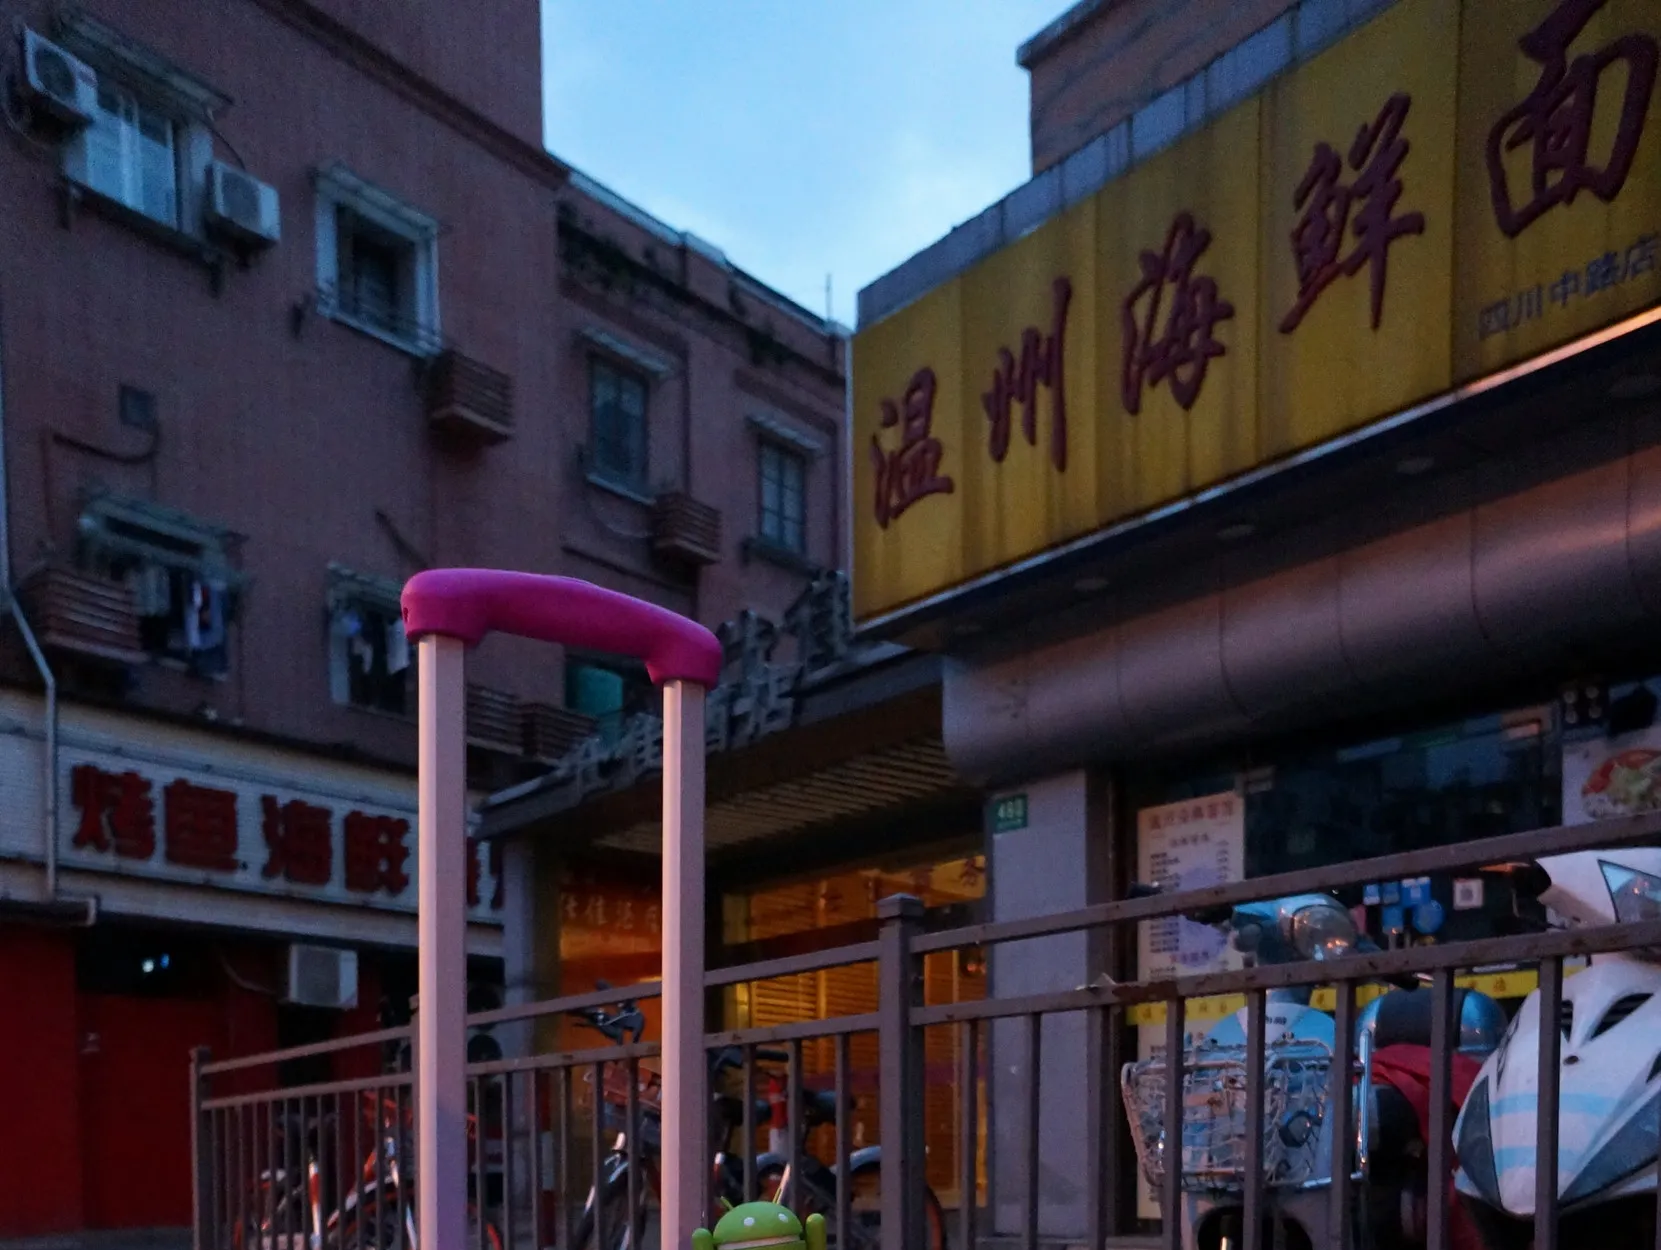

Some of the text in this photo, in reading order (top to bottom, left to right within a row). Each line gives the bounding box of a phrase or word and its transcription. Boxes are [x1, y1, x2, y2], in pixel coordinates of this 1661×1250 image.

[872, 0, 1659, 530] 温州海鲜面
[1479, 232, 1661, 340] 四川中路店
[72, 764, 505, 908] 烤鱼海鲜
